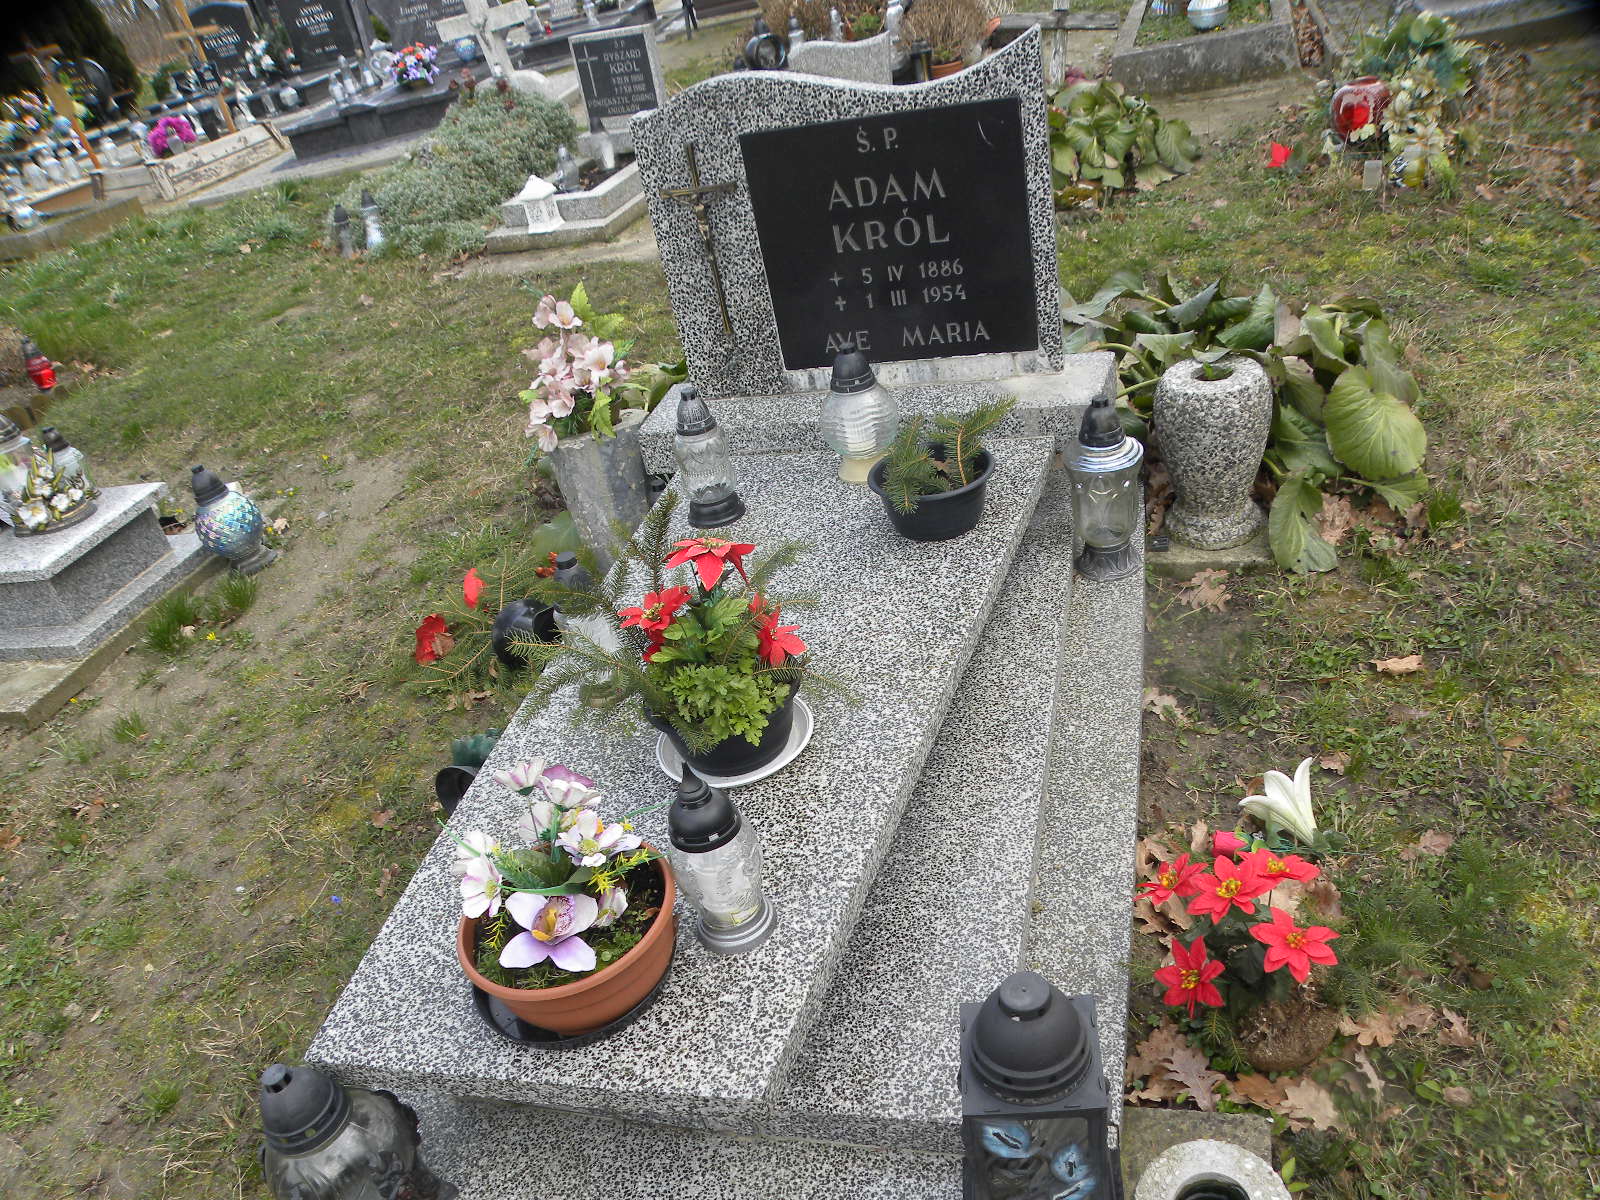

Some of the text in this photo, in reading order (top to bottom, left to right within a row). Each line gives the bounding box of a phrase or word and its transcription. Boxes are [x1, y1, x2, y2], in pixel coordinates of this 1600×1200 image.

[828, 168, 946, 211] ADAM
[832, 207, 950, 254] KRÓL
[861, 267, 873, 284] 5
[887, 264, 904, 282] IV
[919, 258, 964, 279] 1886
[866, 293, 874, 309] 1
[890, 289, 907, 306] III
[921, 284, 967, 304] 1954
[825, 319, 991, 353] AVE MARIA
